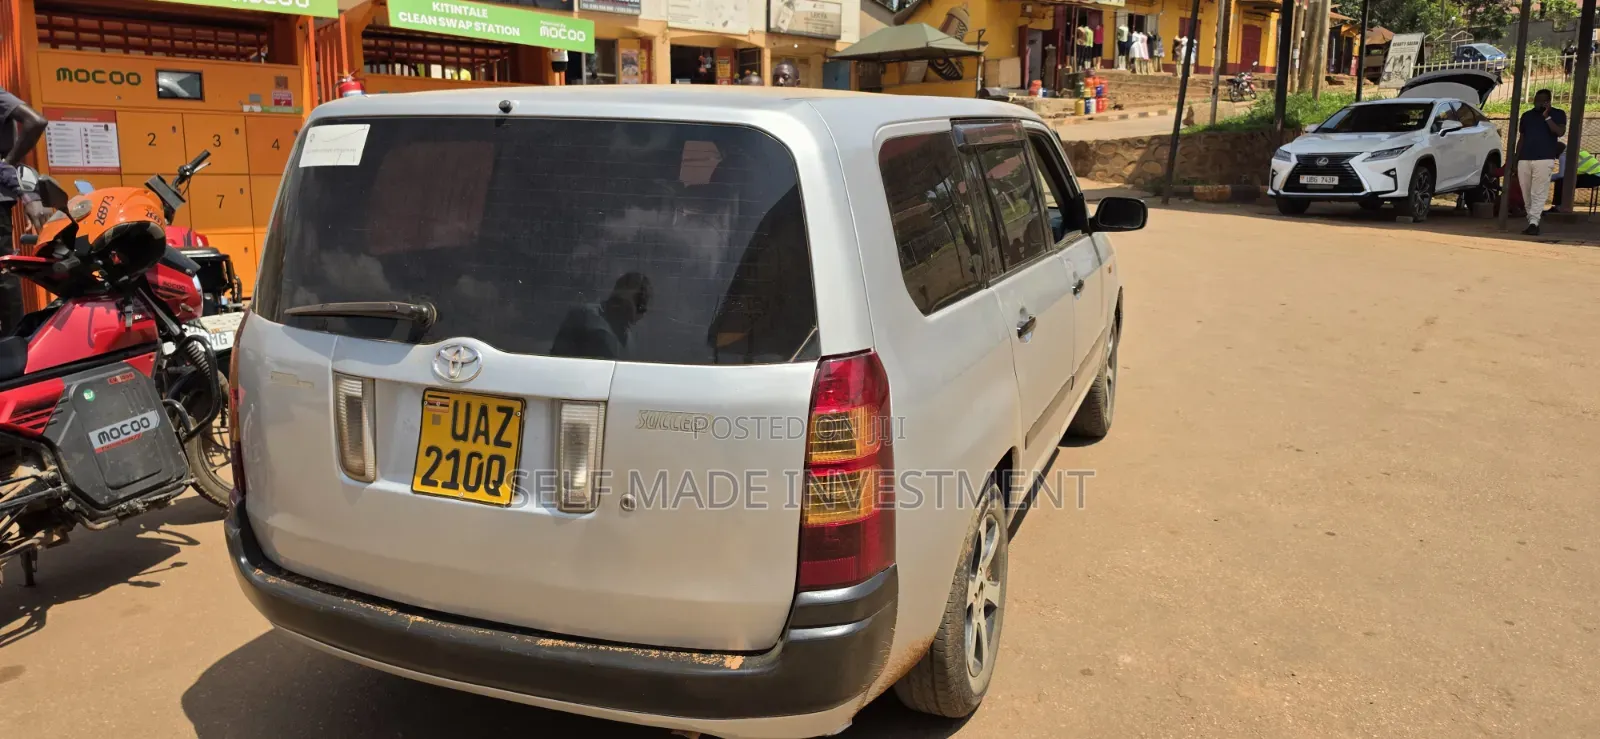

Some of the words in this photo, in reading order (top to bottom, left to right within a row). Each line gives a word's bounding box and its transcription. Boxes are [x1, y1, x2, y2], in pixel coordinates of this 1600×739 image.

[432, 2, 488, 18] KITINTALE
[398, 11, 437, 26] CLEAN
[438, 17, 472, 31] SWAP
[474, 21, 520, 36] STATION
[540, 26, 586, 42] MOCOO
[56, 67, 142, 86] MOCOO
[147, 132, 157, 147] 2
[212, 134, 222, 148] 3
[271, 138, 281, 151] 4
[216, 194, 225, 209] 7
[94, 195, 115, 226] 26973
[97, 417, 151, 445] MOCOO
[451, 400, 514, 448] UAZ
[420, 445, 507, 497] 210Q
